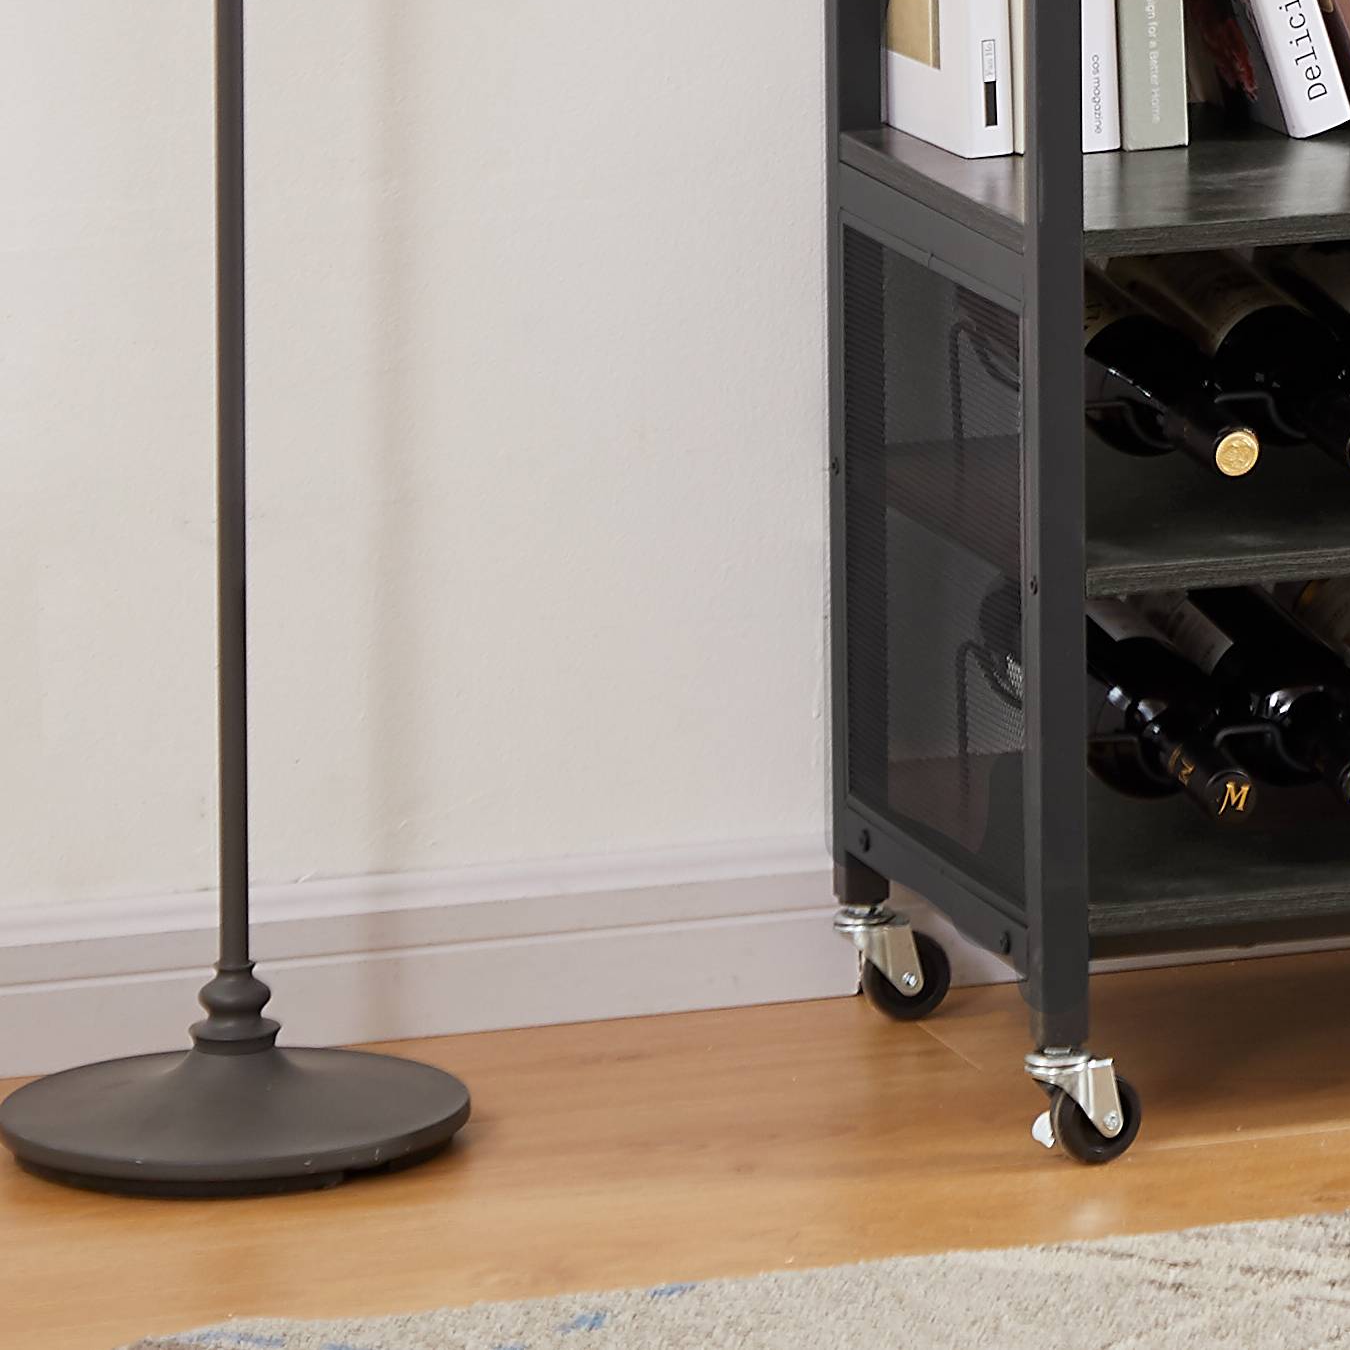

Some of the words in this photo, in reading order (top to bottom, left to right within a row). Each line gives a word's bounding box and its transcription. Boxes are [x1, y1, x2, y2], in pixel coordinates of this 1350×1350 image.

[1147, 22, 1158, 37] for
[1091, 54, 1100, 75] cos
[1091, 76, 1103, 134] magazine
[1218, 781, 1251, 815] M
